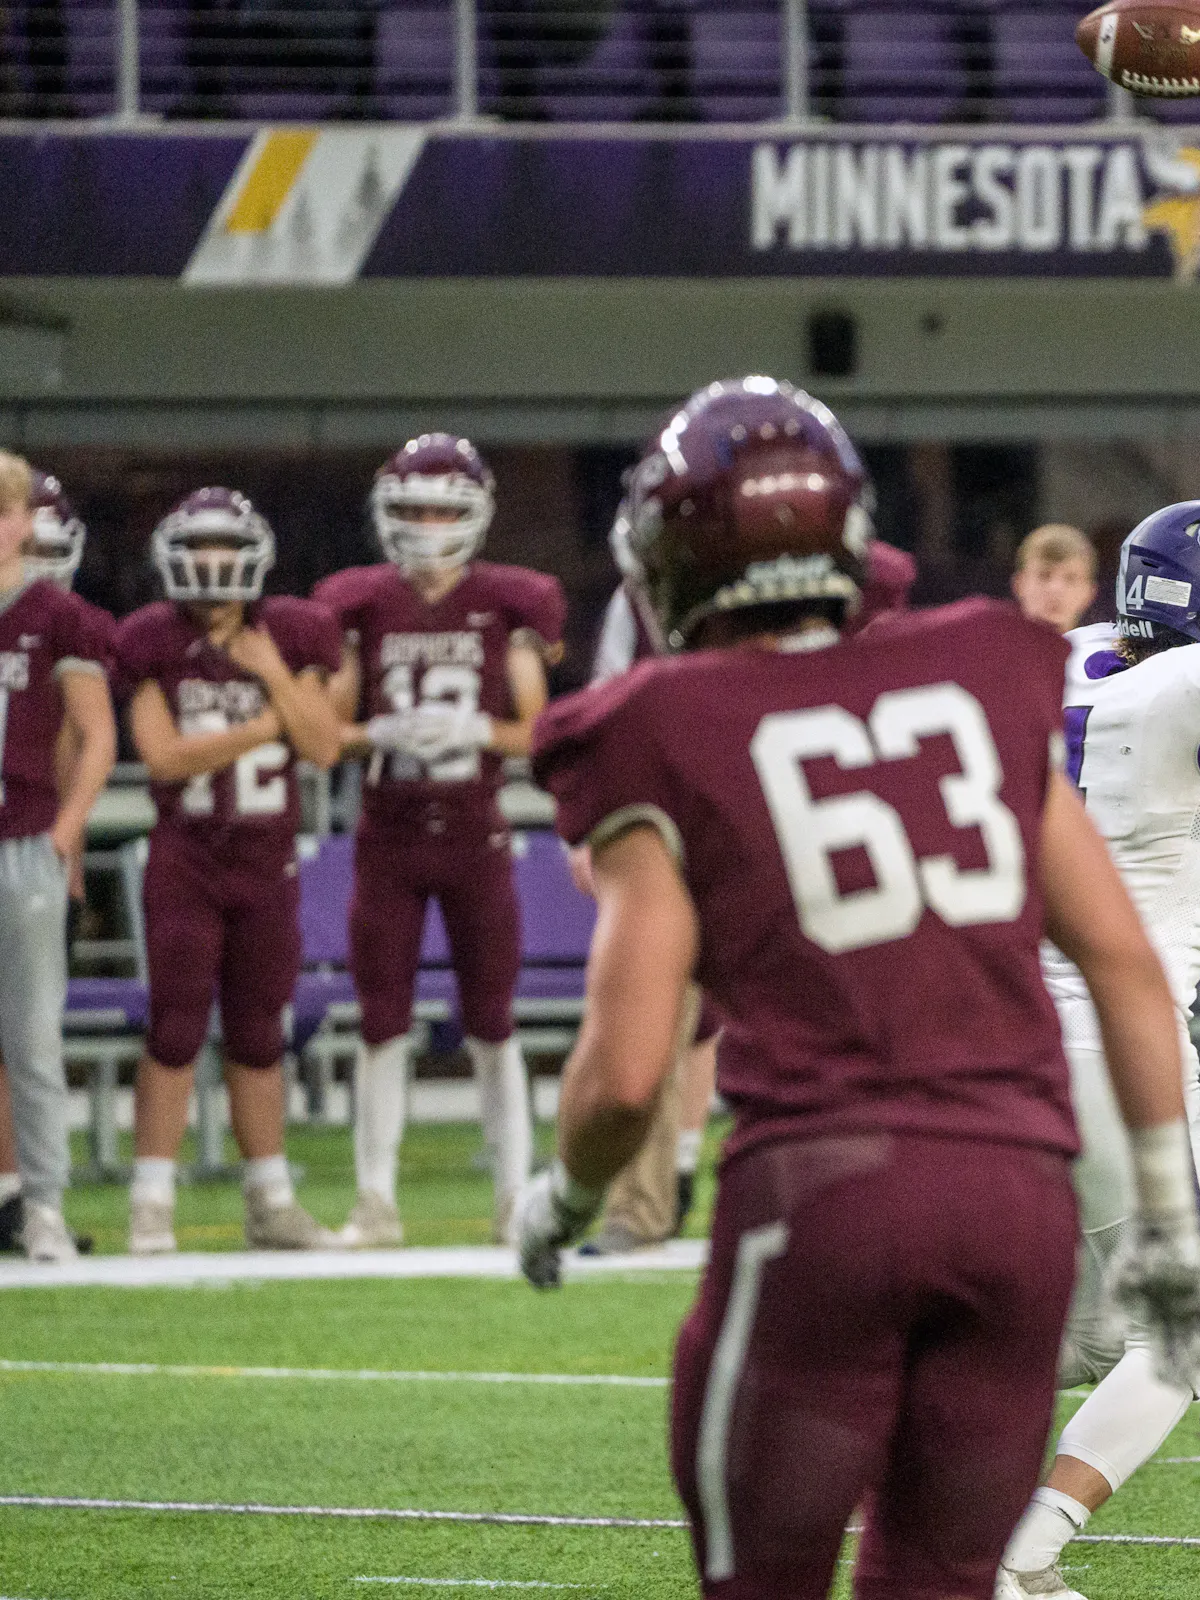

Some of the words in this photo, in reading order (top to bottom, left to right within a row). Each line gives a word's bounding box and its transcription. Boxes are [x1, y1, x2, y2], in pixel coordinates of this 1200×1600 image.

[752, 144, 1147, 250] MINNESOTA
[1126, 575, 1144, 610] 4
[750, 681, 1026, 954] 63
